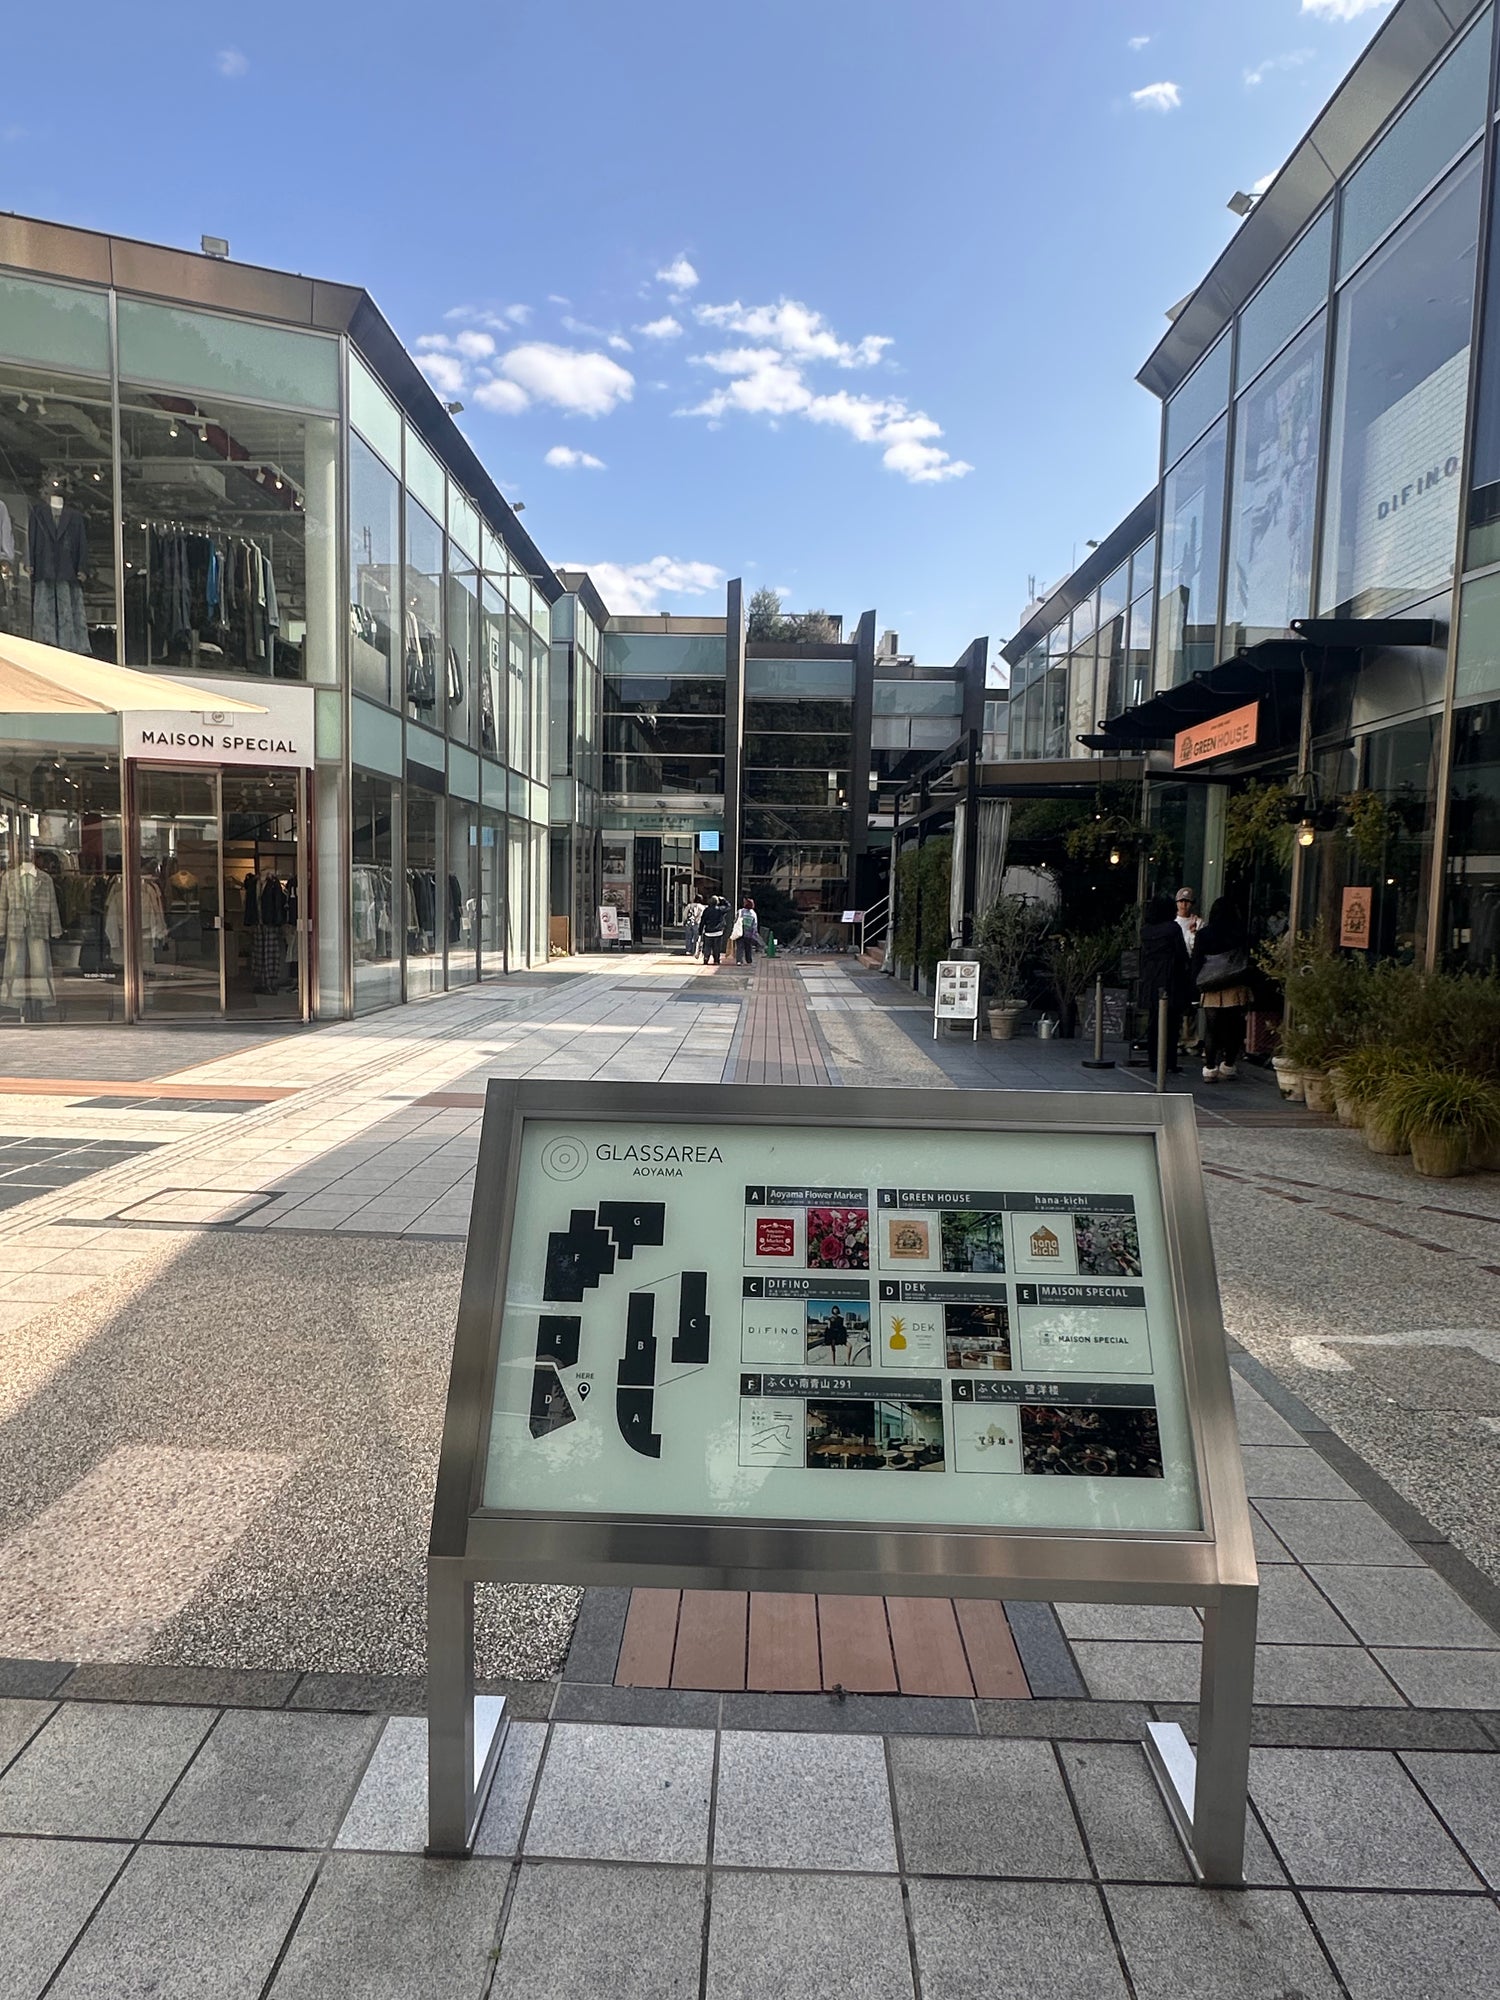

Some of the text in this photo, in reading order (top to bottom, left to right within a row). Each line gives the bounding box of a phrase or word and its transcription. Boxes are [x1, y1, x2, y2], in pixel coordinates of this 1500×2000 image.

[1377, 456, 1459, 520] DIFINO
[142, 730, 297, 754] MAISON SPECIAL
[1193, 736, 1217, 756] GREEN
[595, 1143, 723, 1163] GLASSAREA
[632, 1166, 684, 1177] AOYAMA
[751, 1191, 759, 1200] A
[770, 1189, 863, 1201] Aoyama Flower Market
[884, 1194, 891, 1203] B
[901, 1192, 972, 1203] GREEN HOUSE
[1034, 1195, 1088, 1205] hana-kichi
[633, 1217, 641, 1226] G
[1032, 1236, 1057, 1247] hana
[574, 1253, 580, 1262] F
[749, 1282, 757, 1292] C
[768, 1279, 810, 1289] DIFINO
[904, 1282, 926, 1292] DEK
[886, 1286, 894, 1296] D
[1023, 1289, 1029, 1299] E
[1041, 1286, 1129, 1298] MAISON SPECIAL
[689, 1318, 697, 1328] C
[912, 1322, 935, 1332] DEK
[555, 1335, 562, 1344] E
[1058, 1335, 1129, 1344] MAISON SPECIAL
[637, 1341, 644, 1350] B
[575, 1372, 595, 1380] HERE
[747, 1379, 754, 1389] F
[767, 1377, 852, 1389] ふくい南青山 291
[958, 1385, 967, 1396] G
[545, 1394, 553, 1404] D
[632, 1413, 640, 1423] A
